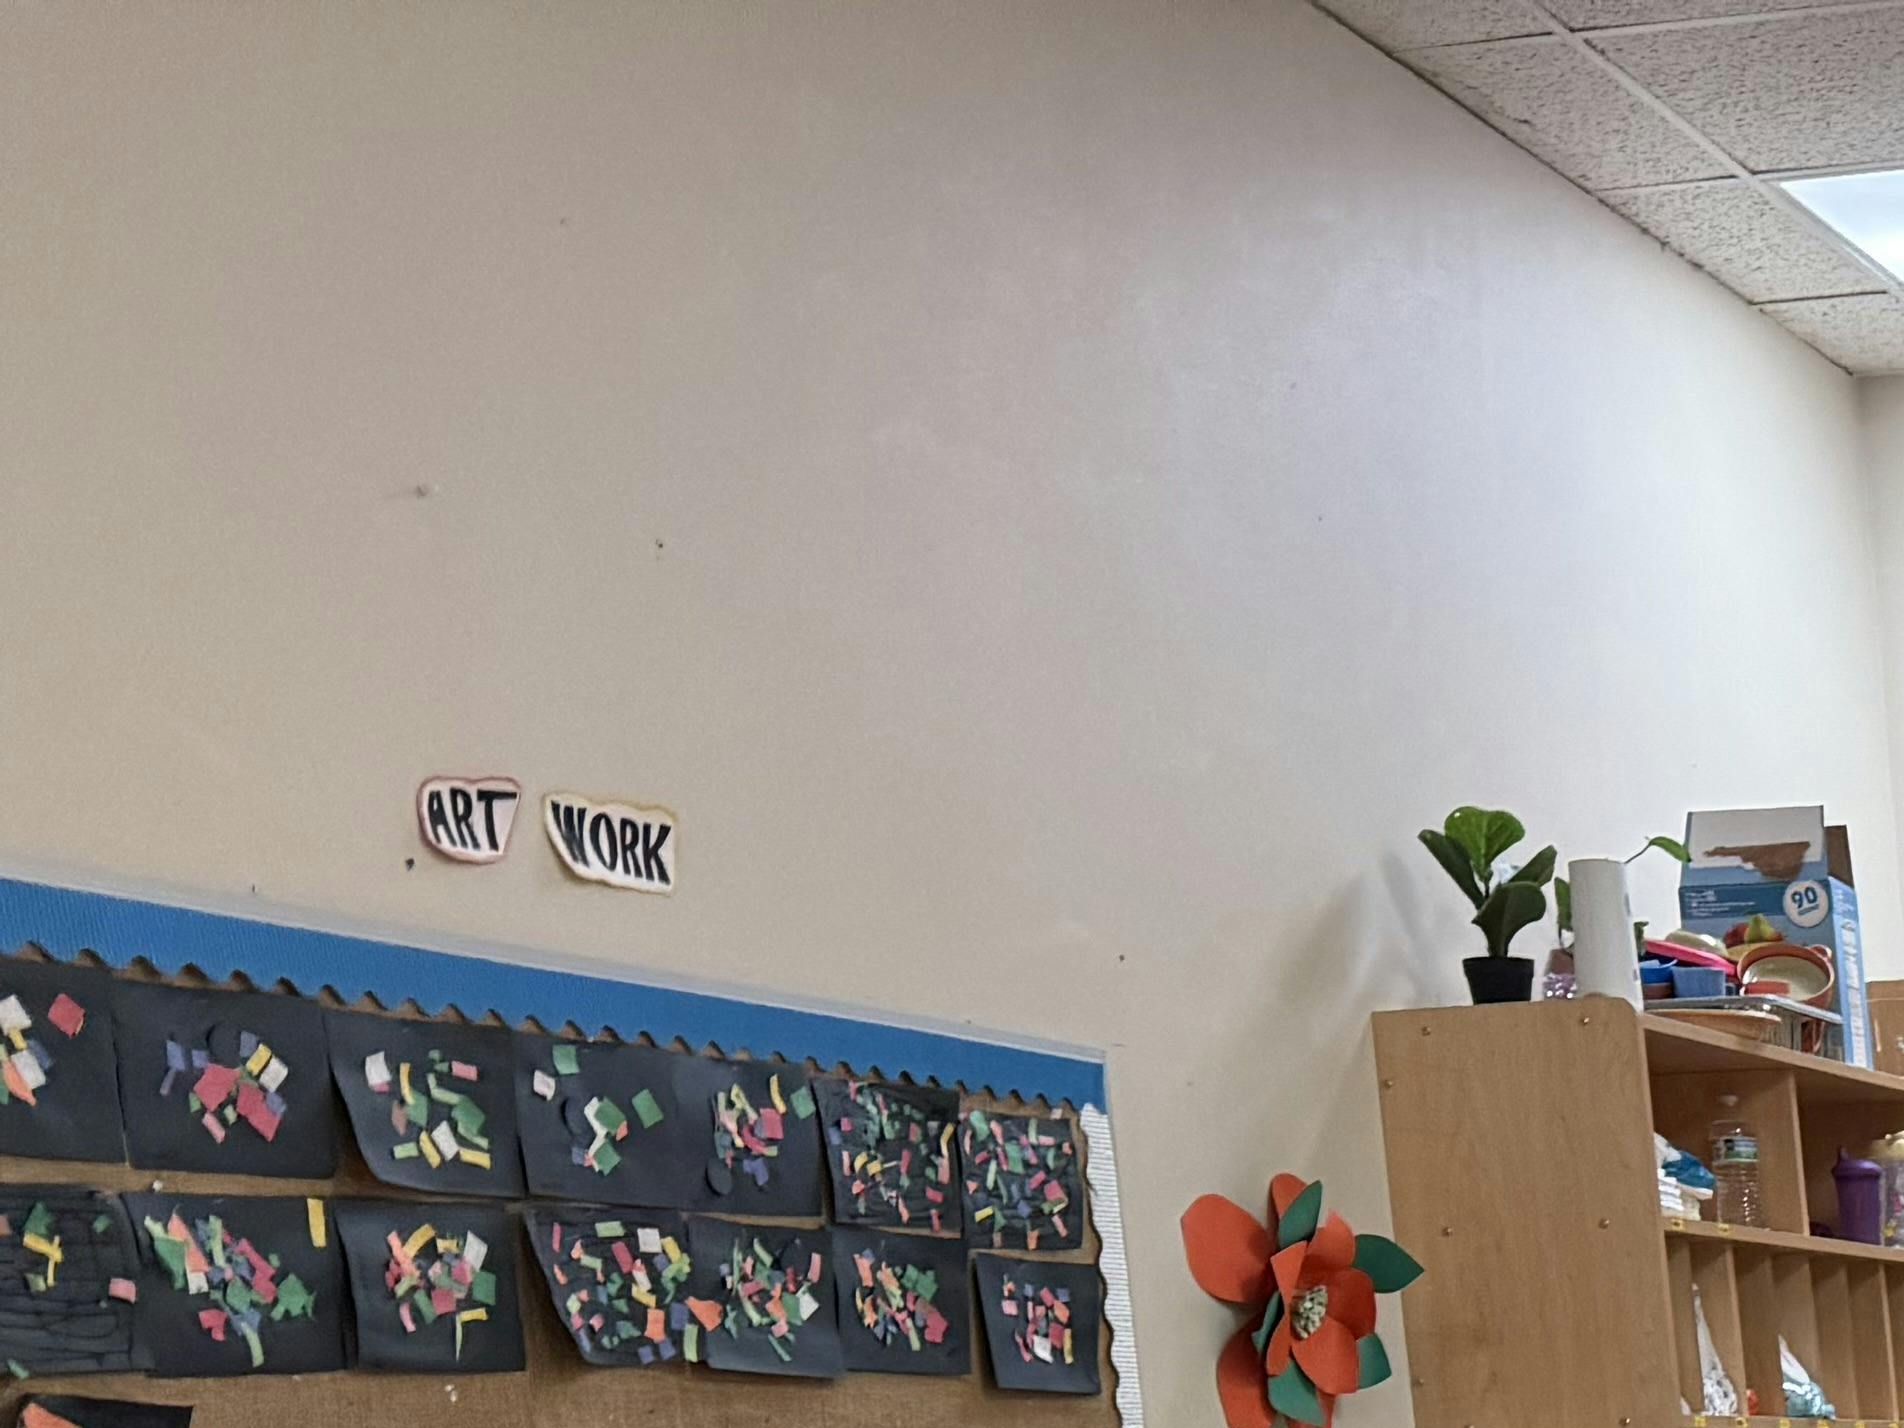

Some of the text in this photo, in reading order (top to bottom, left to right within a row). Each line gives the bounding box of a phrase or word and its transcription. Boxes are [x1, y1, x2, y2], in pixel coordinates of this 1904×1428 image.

[427, 786, 672, 886] ART WORK
[1791, 886, 1819, 909] 90
